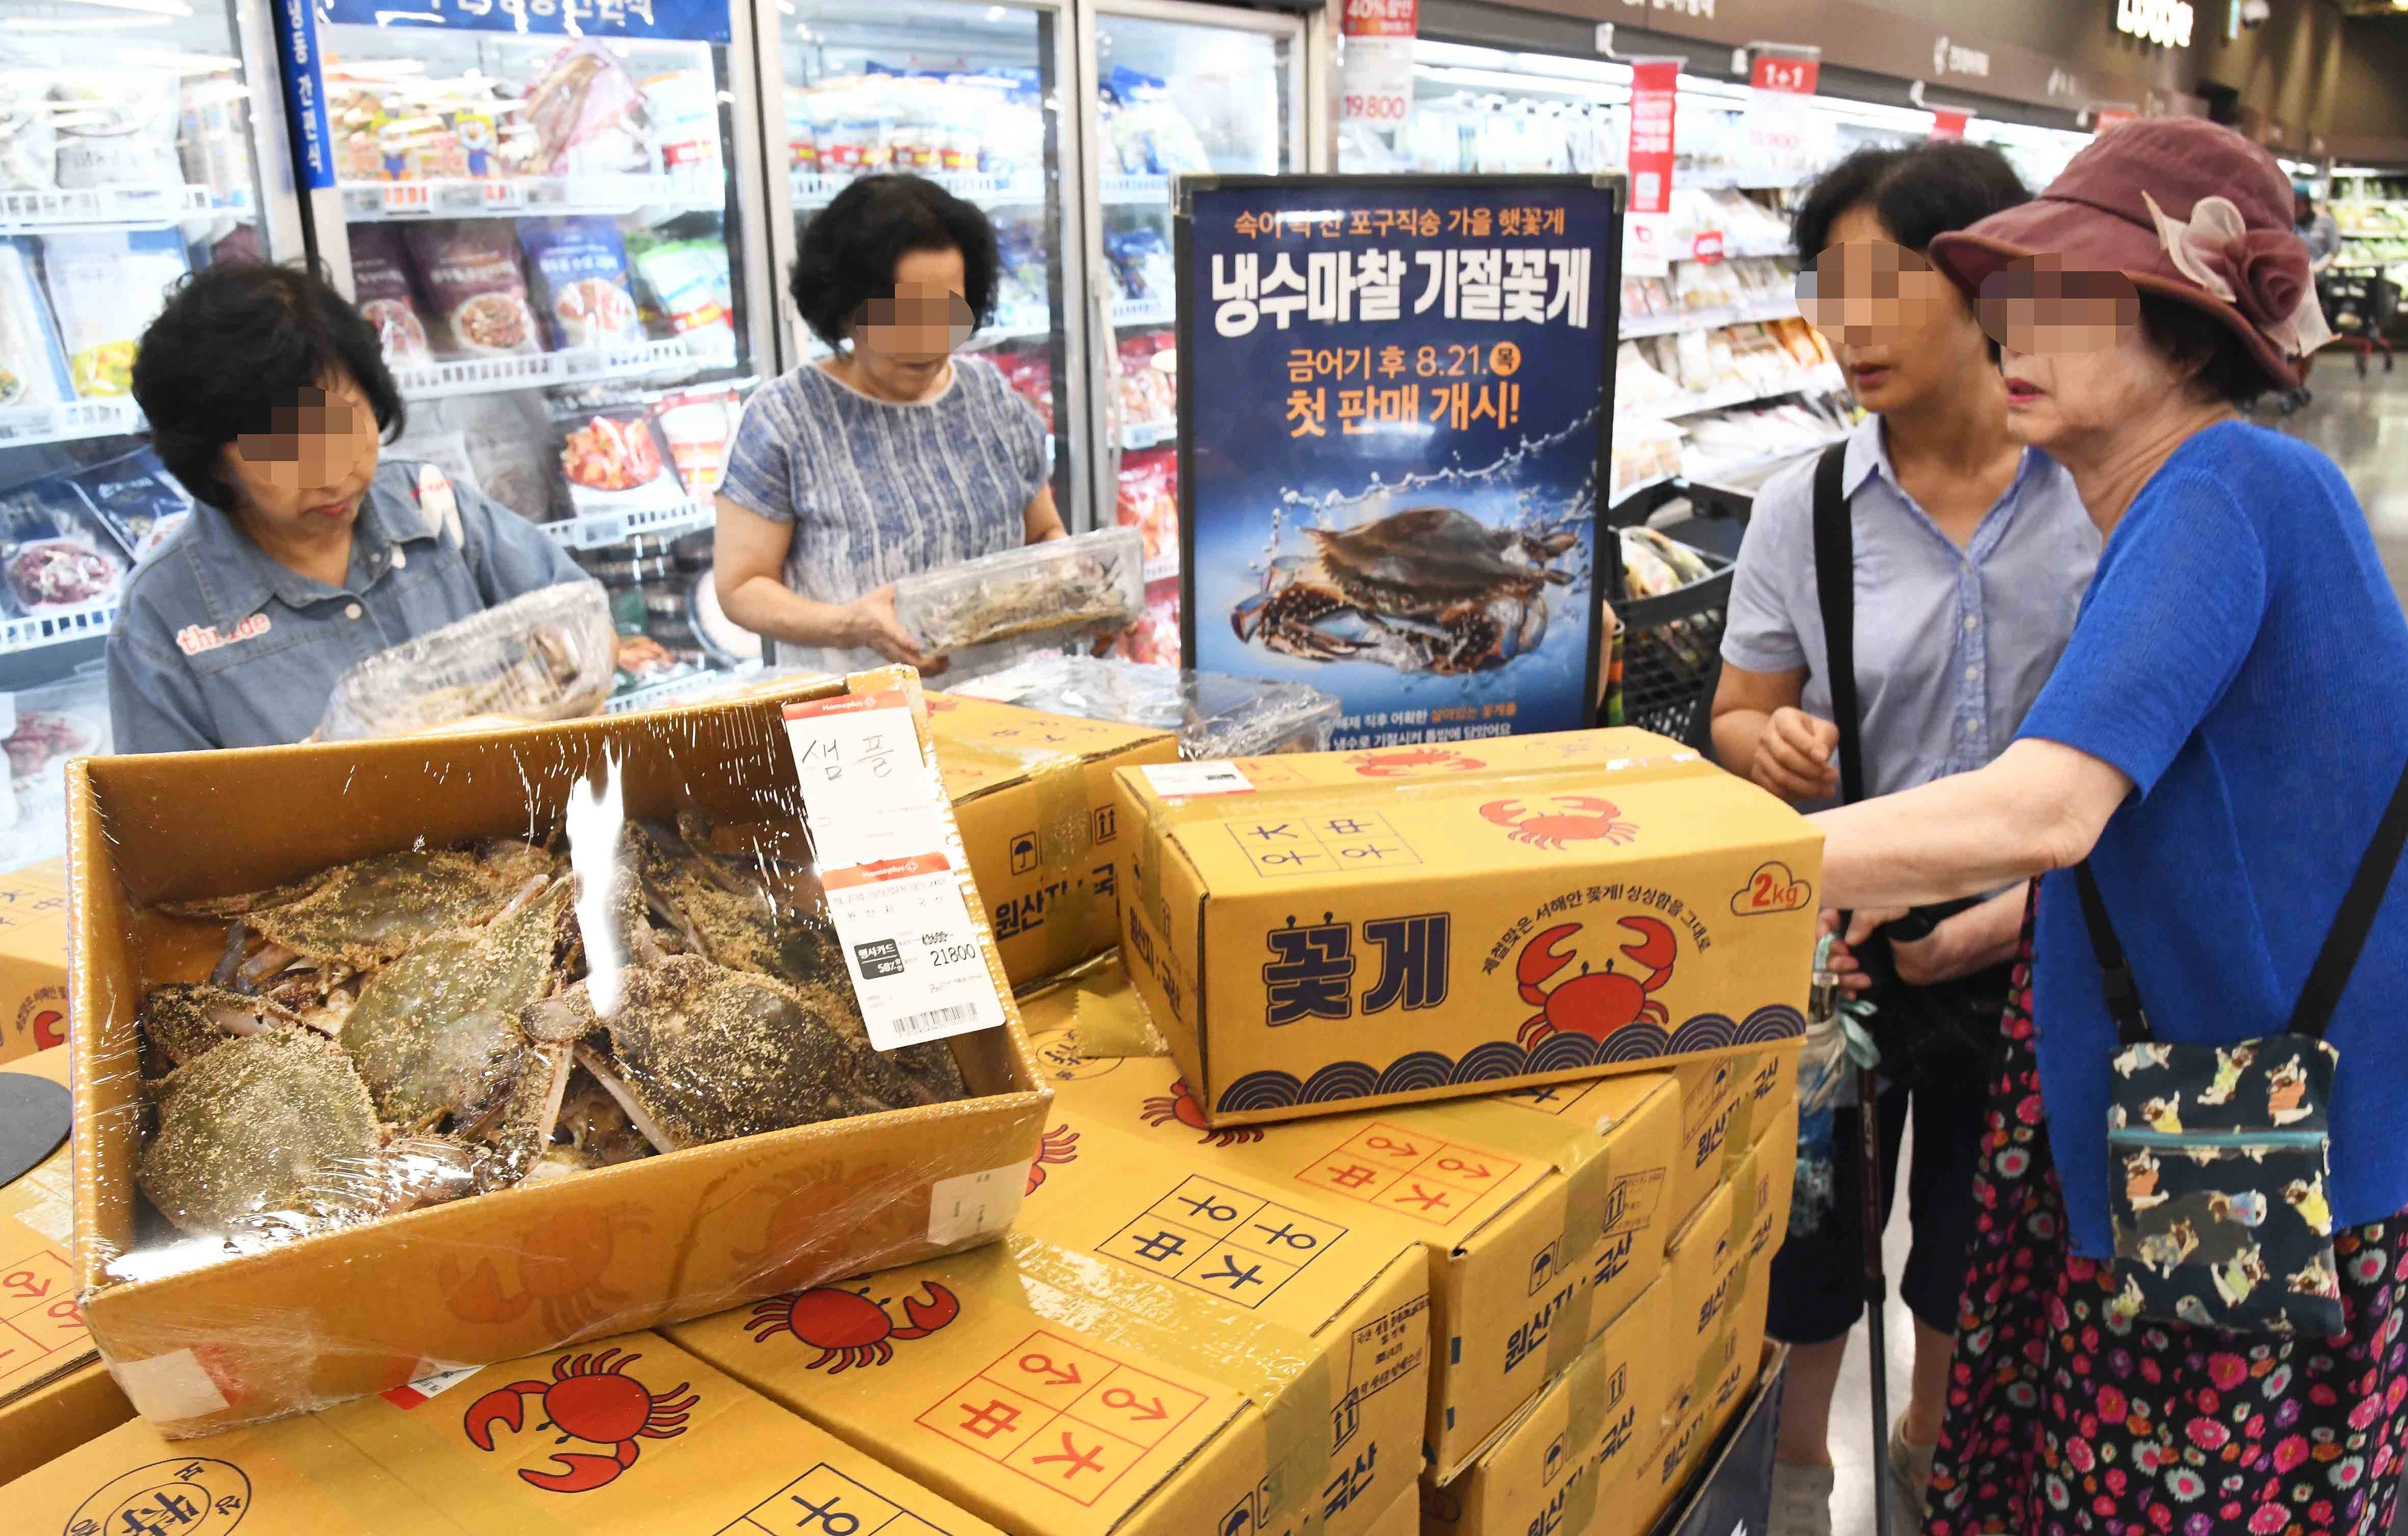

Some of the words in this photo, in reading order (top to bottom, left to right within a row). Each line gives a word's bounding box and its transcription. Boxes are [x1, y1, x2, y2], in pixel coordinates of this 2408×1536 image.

[1764, 64, 1804, 89] 1+1
[1349, 208, 1441, 237] 포구직송
[1448, 208, 1492, 237] 가을
[1499, 207, 1565, 236] 햇꽃게
[1211, 247, 1407, 338] 냉수마찰
[1414, 247, 1591, 329] 기절꽃게
[1286, 347, 1371, 383] 금어기
[1377, 344, 1406, 380] 후
[1286, 387, 1326, 438] 첫
[1337, 384, 1419, 436] 판매
[1429, 381, 1520, 431] 개시!
[1536, 890, 1583, 921] 서해안
[1587, 884, 1624, 904] 꽃게!
[1627, 885, 1684, 917] 싱싱함을
[1680, 910, 1711, 954] 그대로
[1751, 873, 1798, 908] 2kg
[1262, 912, 1451, 1027] 꽃게
[1592, 1231, 1633, 1288] 국산
[1600, 1405, 1635, 1465] 국산
